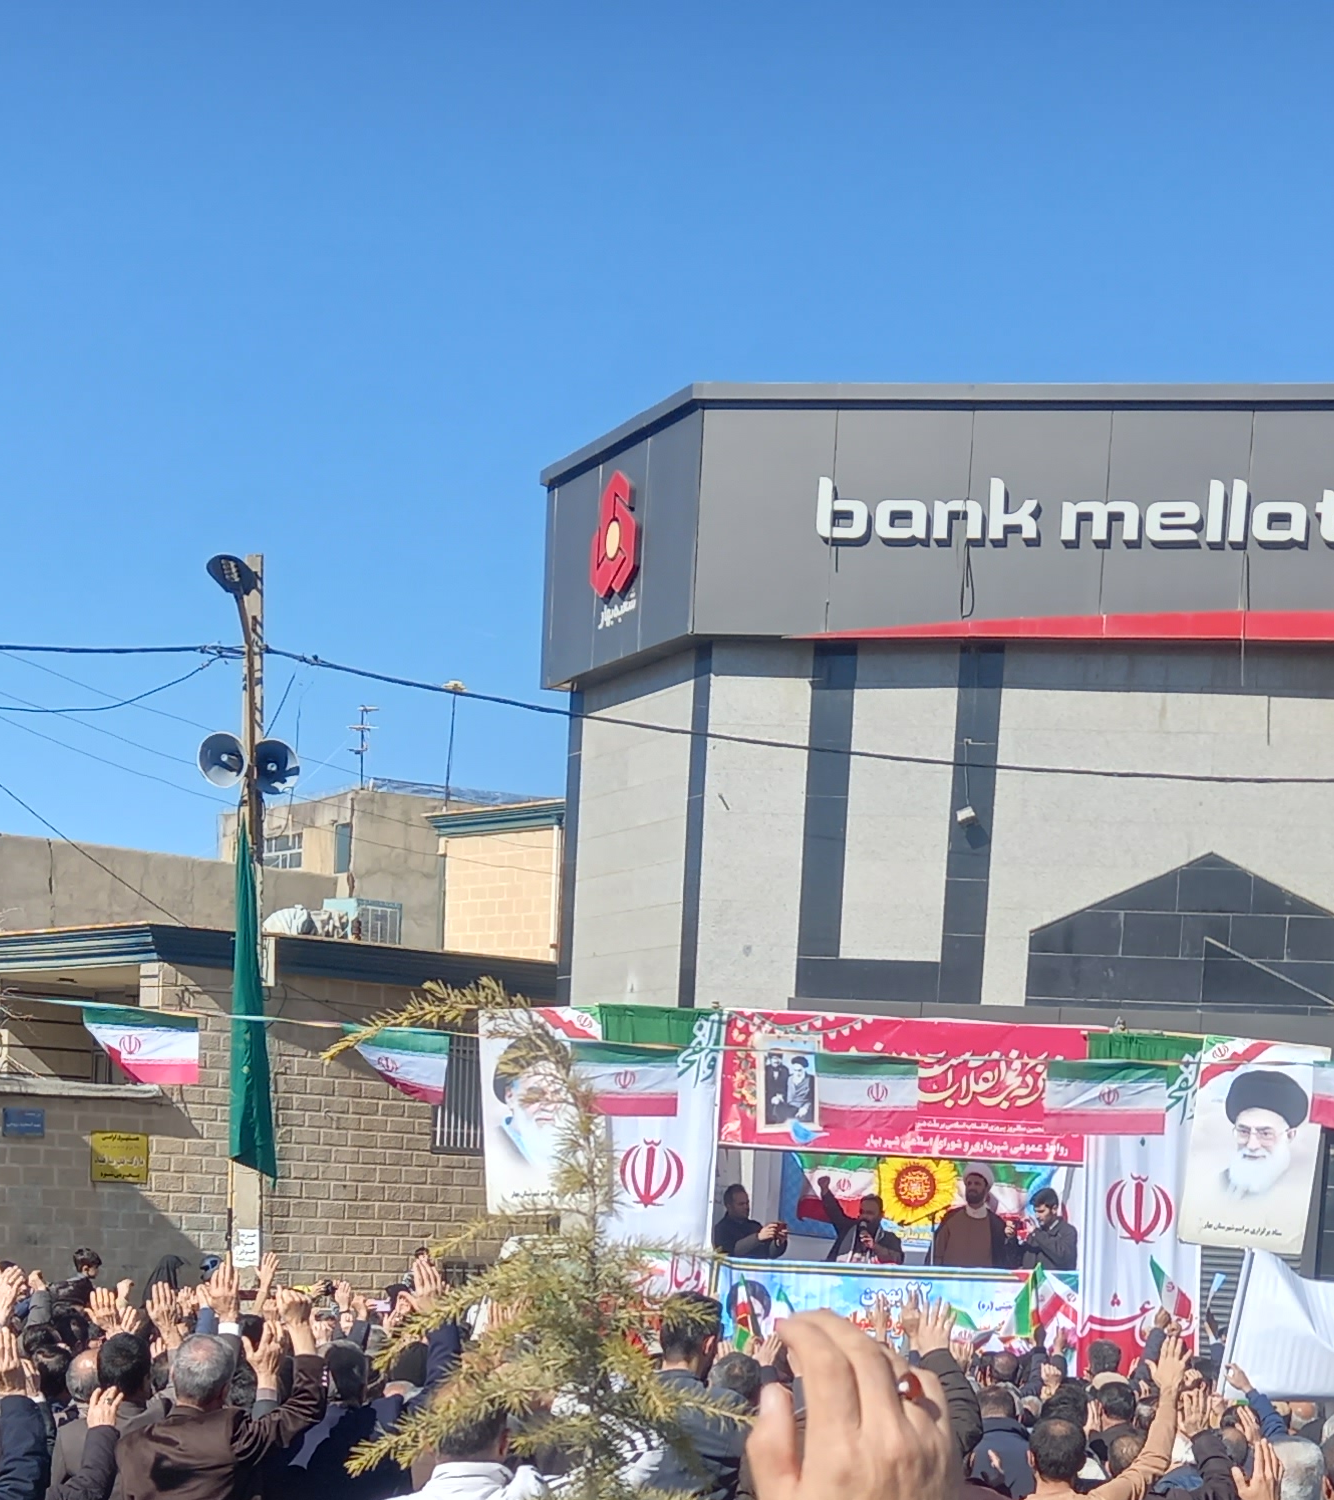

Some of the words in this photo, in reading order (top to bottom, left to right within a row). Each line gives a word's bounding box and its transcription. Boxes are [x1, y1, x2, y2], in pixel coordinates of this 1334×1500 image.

[817, 477, 1039, 542] bank
[883, 1135, 901, 1149] شهر
[1009, 1142, 1044, 1155] عمومی
